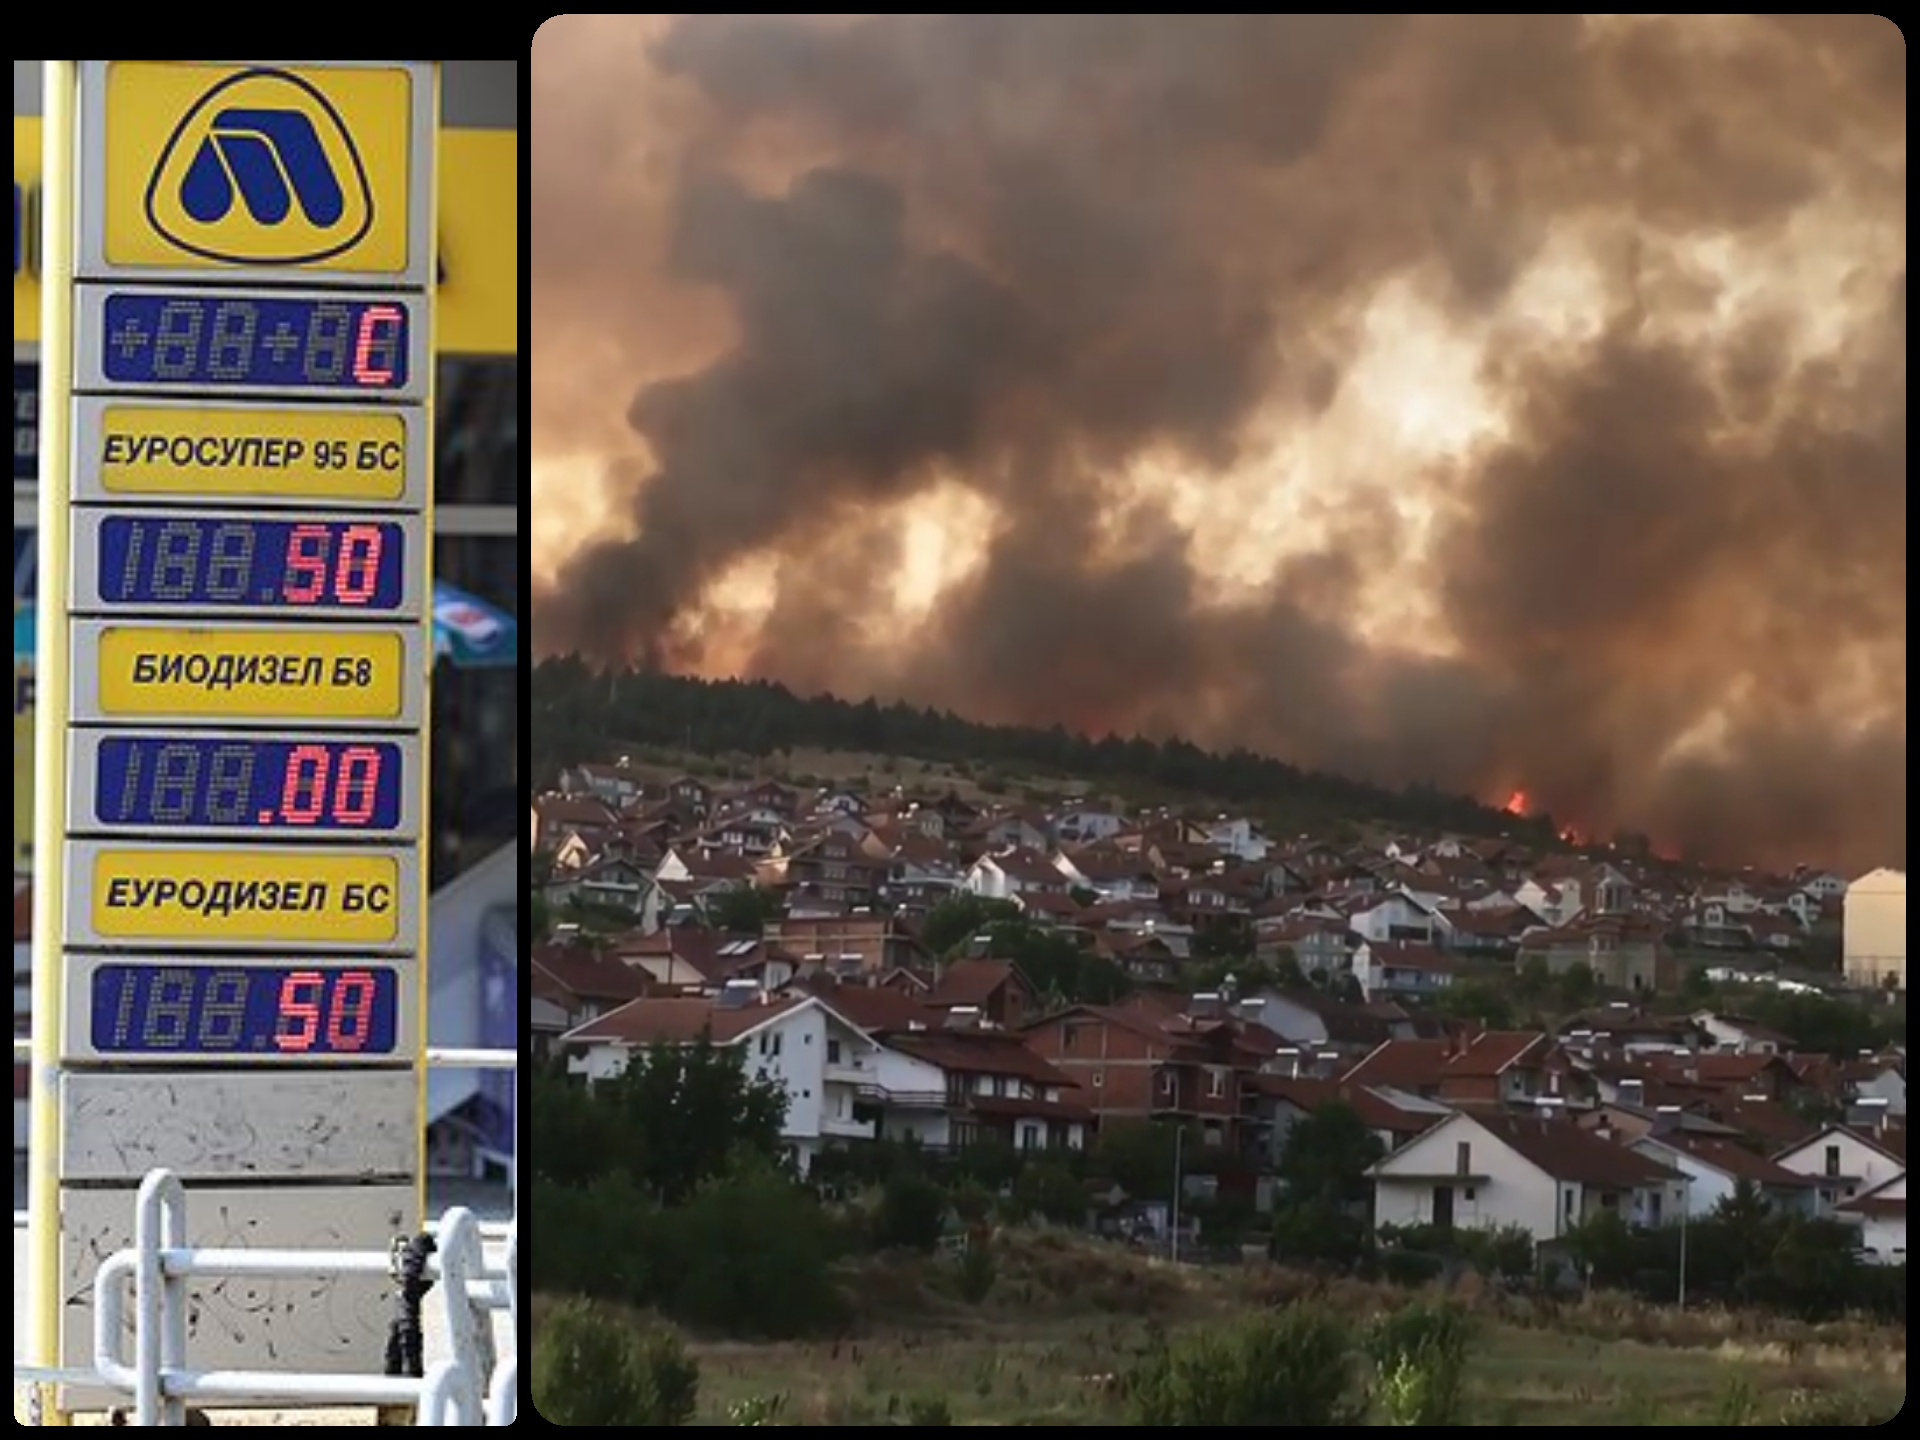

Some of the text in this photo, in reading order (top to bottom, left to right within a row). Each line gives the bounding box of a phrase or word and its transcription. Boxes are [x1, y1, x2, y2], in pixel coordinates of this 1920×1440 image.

[103, 435, 400, 470] ЕУРОСУПЕР 95 БС
[132, 654, 372, 690] БИОДИЗЕЛ Б8
[106, 878, 390, 917] ЕУРОДИЗЕЛ БС
